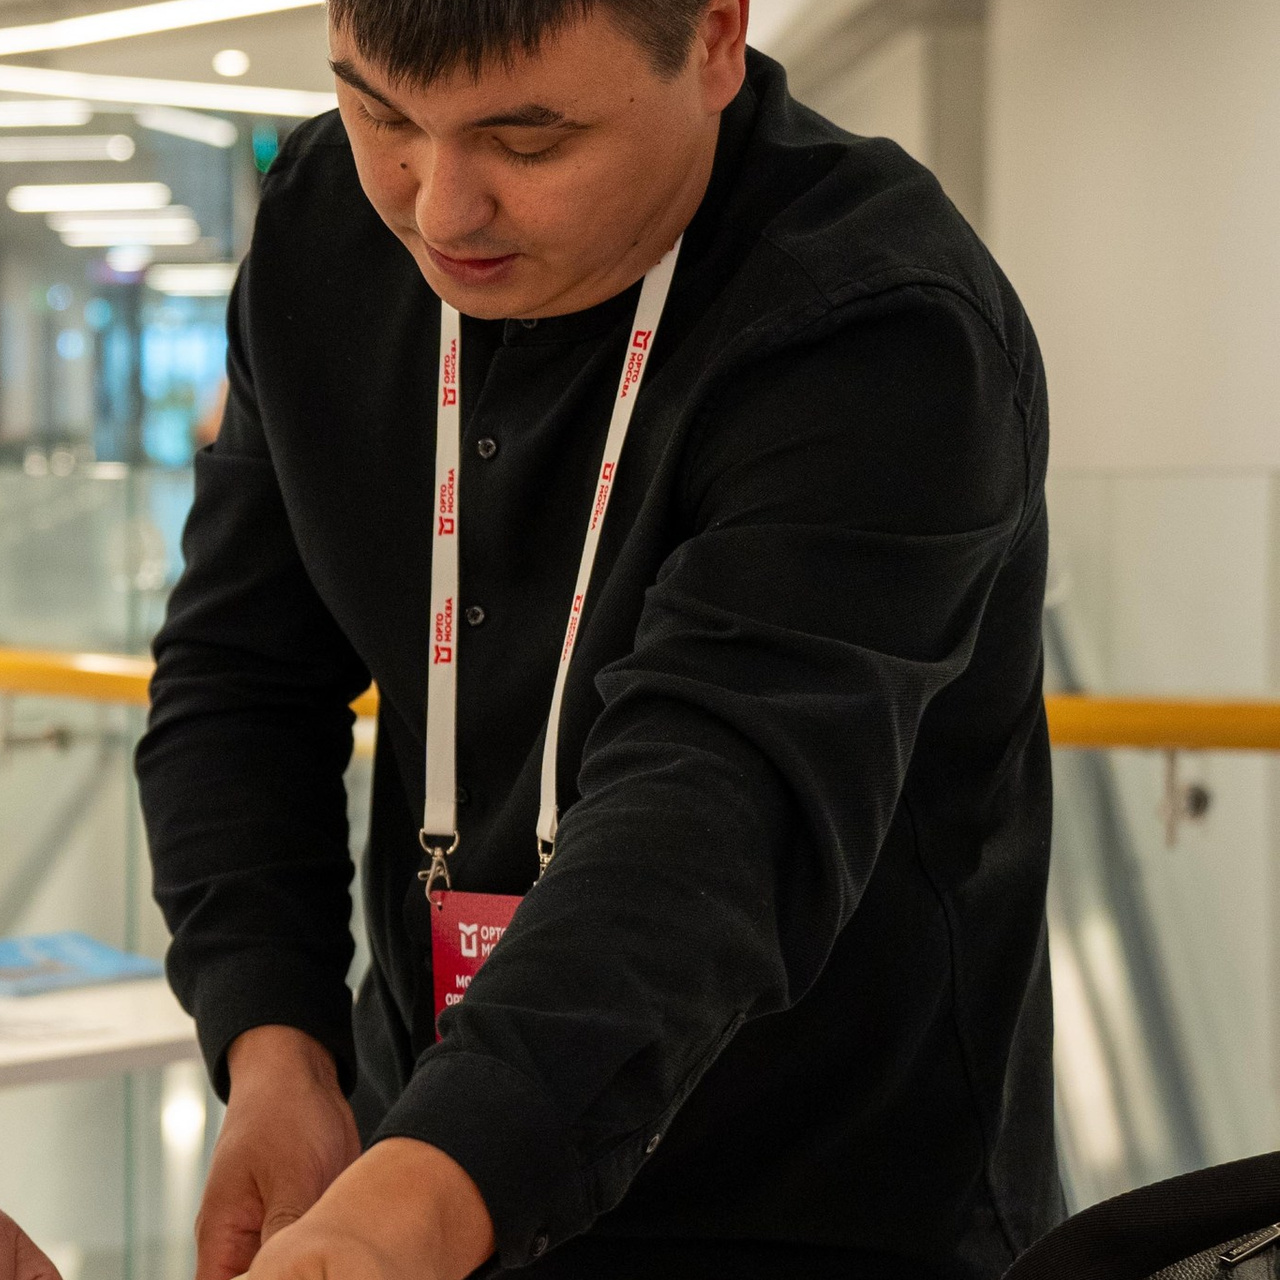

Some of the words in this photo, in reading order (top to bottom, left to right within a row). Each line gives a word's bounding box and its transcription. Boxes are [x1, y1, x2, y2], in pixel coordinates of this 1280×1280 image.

[620, 352, 637, 398] МОСКВА
[631, 353, 644, 383] ОРТО
[447, 468, 455, 513] МОСКВА
[435, 613, 444, 642] ОРТО
[444, 597, 453, 642] МОСКВА
